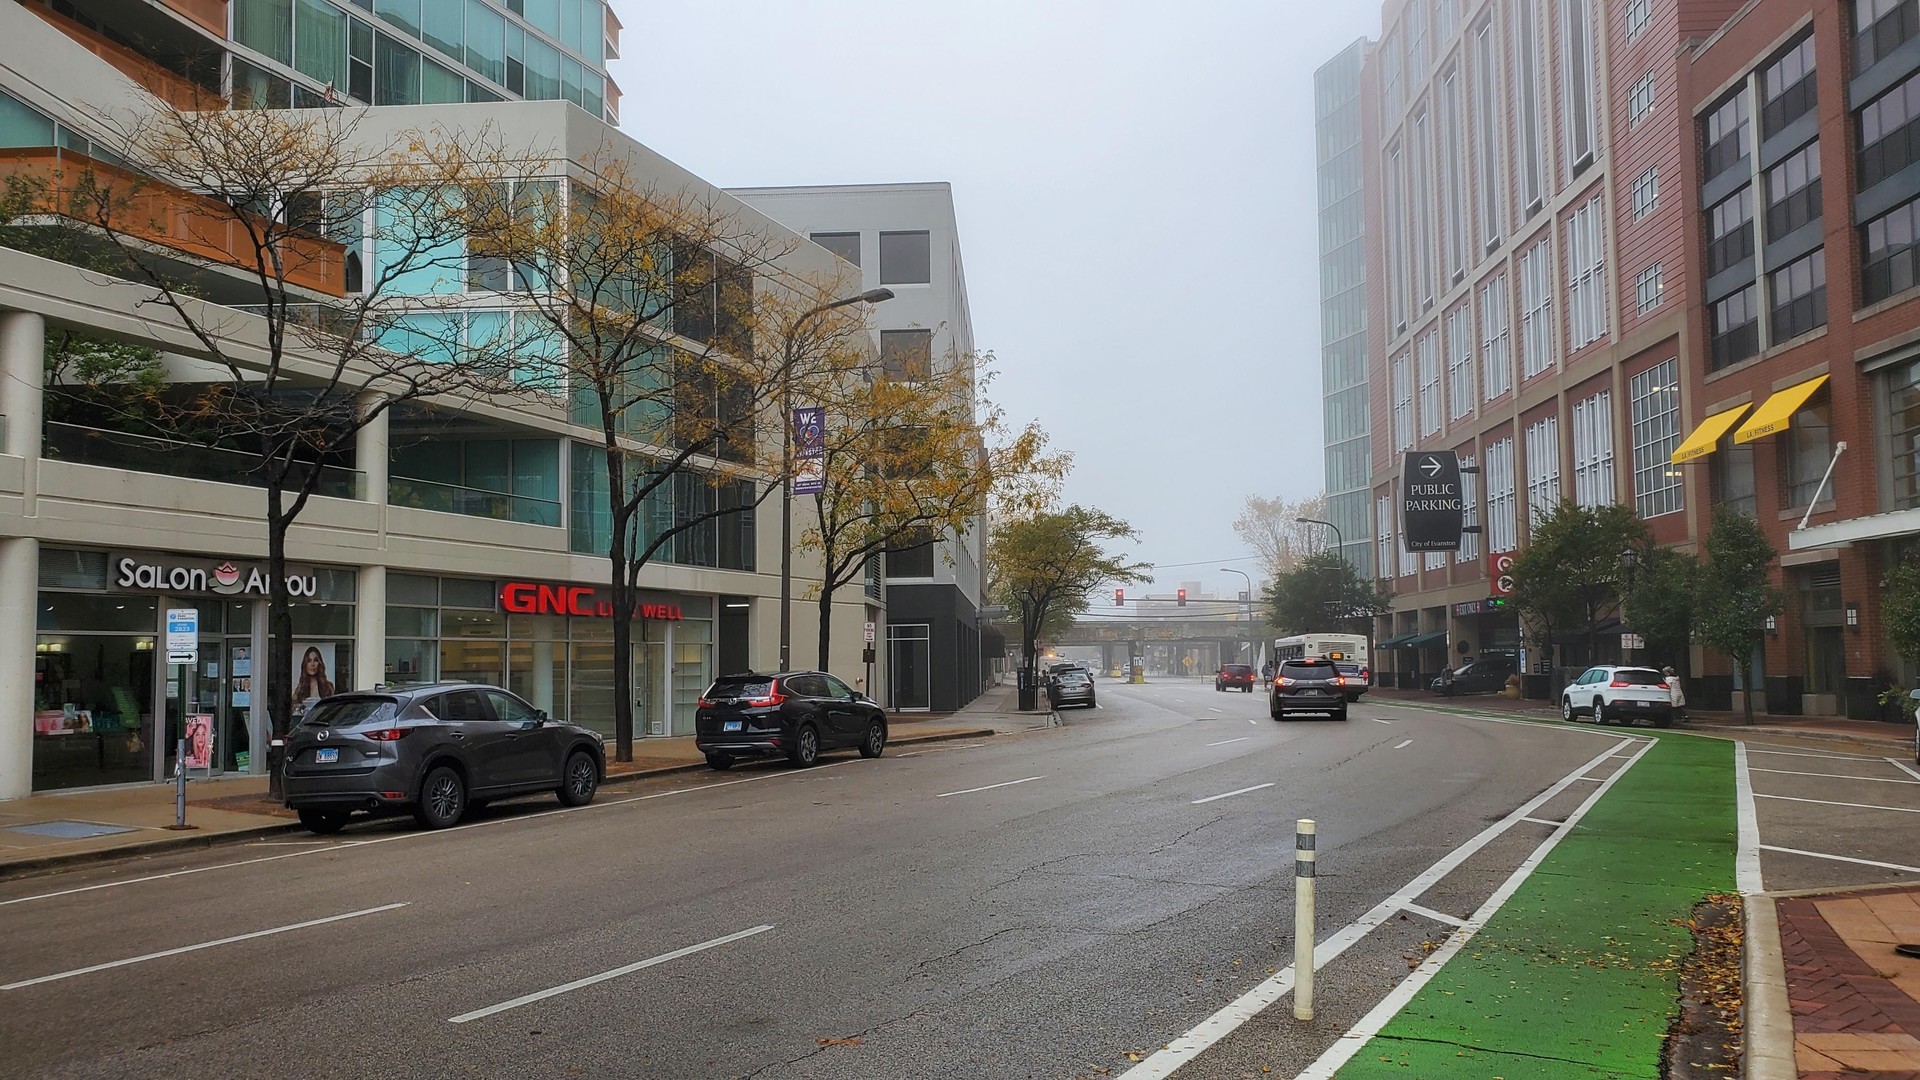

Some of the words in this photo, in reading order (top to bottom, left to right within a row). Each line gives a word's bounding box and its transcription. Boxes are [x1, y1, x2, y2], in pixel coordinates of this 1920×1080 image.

[800, 412, 817, 425] WE
[1754, 424, 1775, 436] FITNESS
[1410, 484, 1455, 495] PUBLIC
[1405, 499, 1461, 511] PARKING
[1411, 540, 1423, 548] City
[502, 582, 595, 616] GNC
[642, 604, 685, 620] WELL
